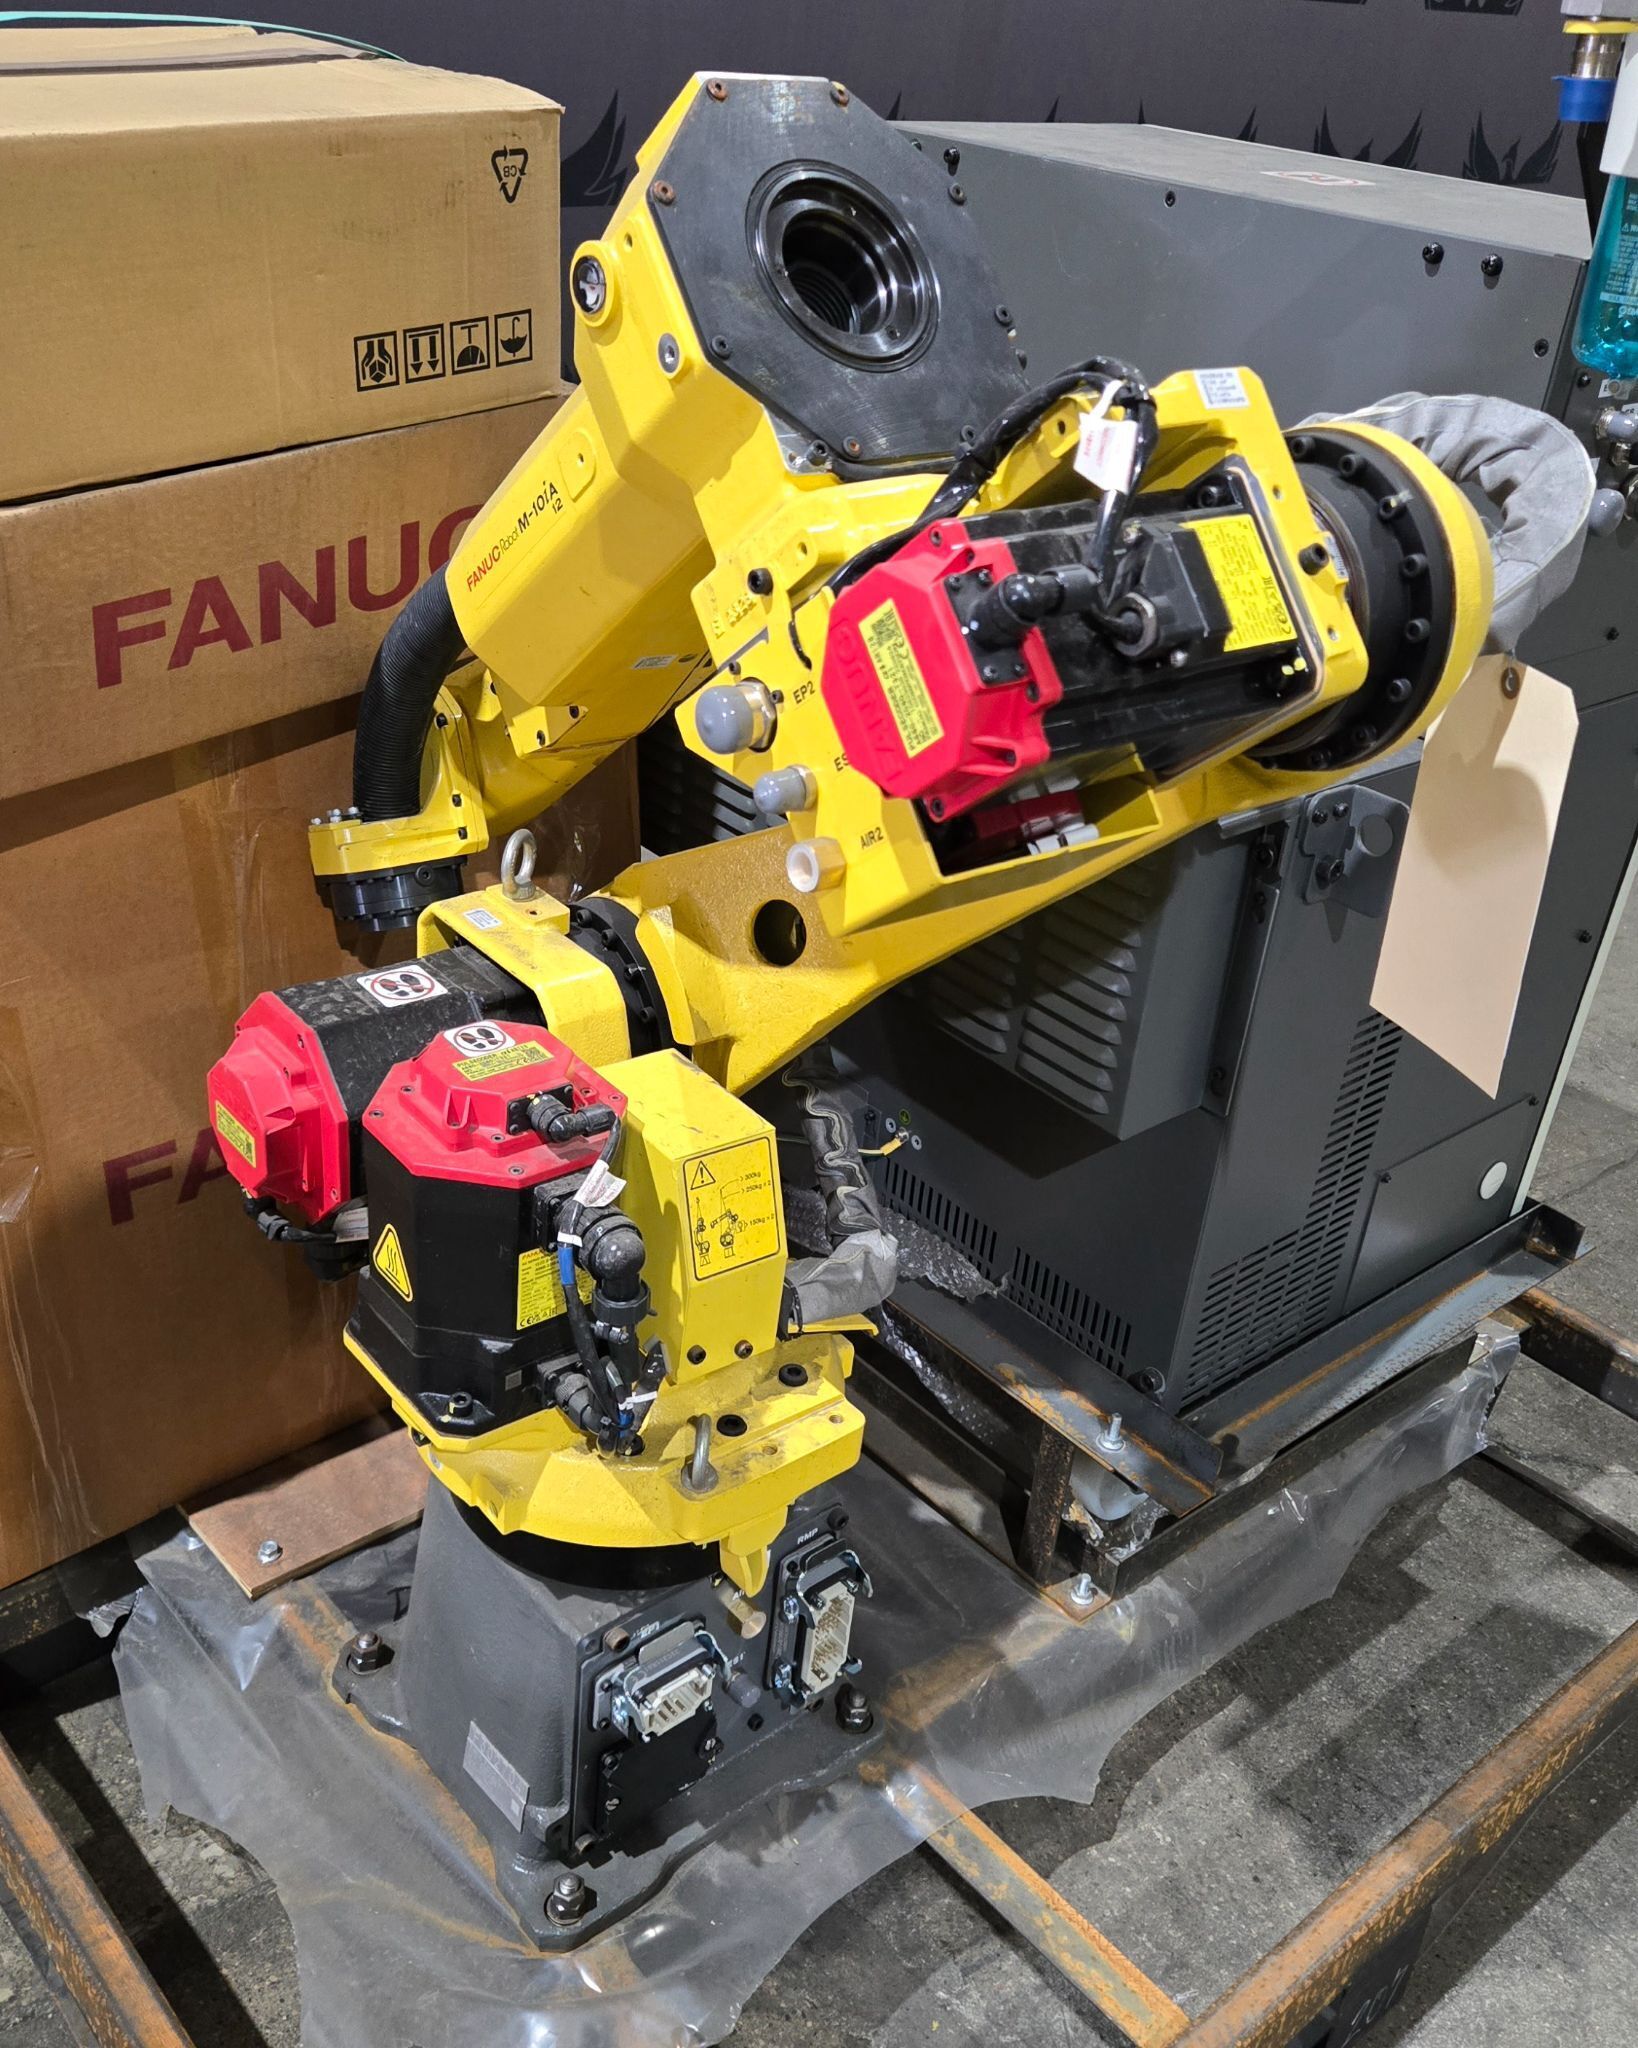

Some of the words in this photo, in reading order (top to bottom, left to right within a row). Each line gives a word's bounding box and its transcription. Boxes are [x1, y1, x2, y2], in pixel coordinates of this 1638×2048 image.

[552, 498, 563, 514] 12
[466, 545, 501, 592] FANUC
[499, 527, 519, 555] Robot
[793, 681, 816, 704] EP2
[860, 827, 884, 850] AIR2
[103, 1126, 230, 1225] FA
[745, 1171, 761, 1181] 300kg
[750, 1217, 766, 1226] 150kg
[797, 1528, 819, 1545] RMP
